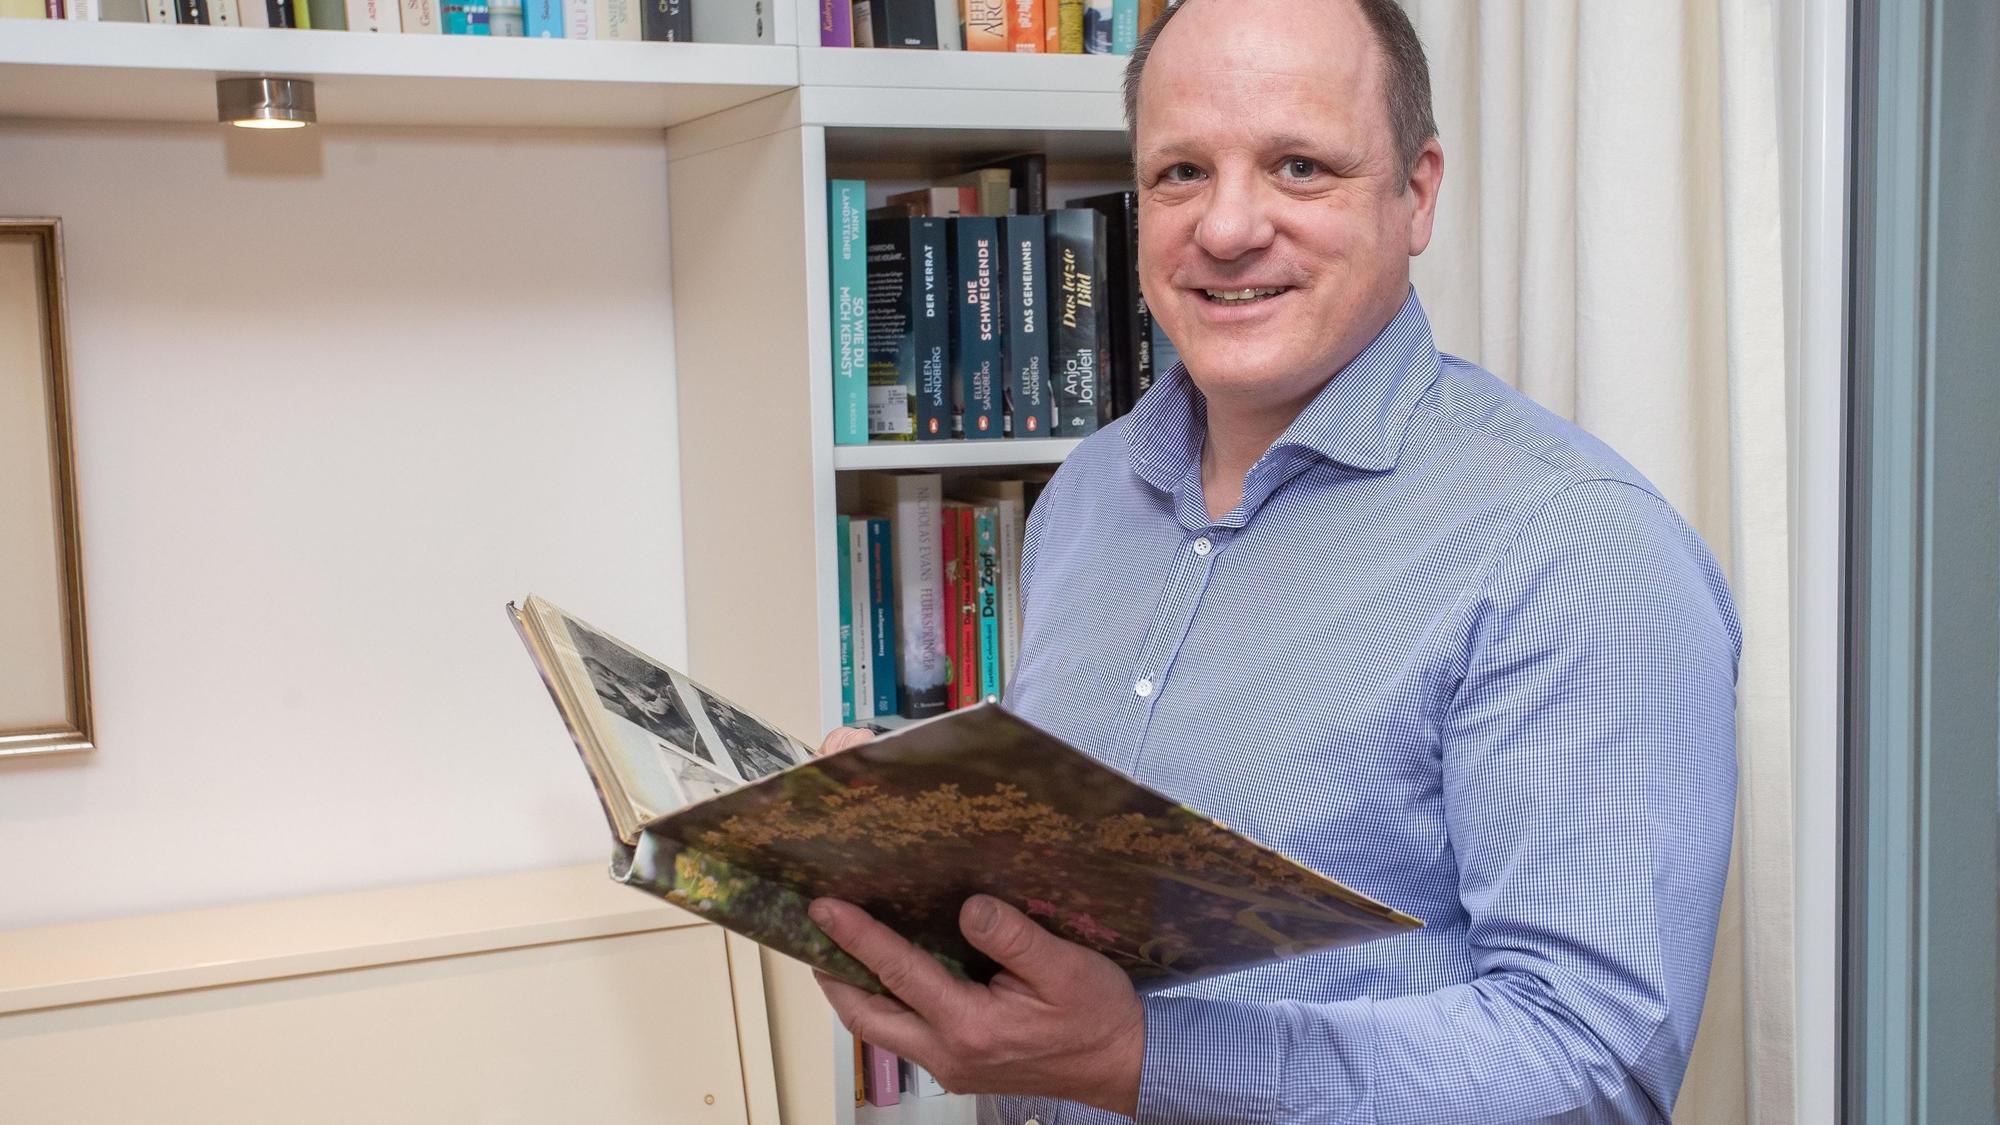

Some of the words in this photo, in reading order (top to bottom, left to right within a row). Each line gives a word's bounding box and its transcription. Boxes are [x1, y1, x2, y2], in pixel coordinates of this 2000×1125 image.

[842, 187, 851, 260] LANDSTEINER
[851, 207, 859, 241] ANIKA
[924, 245, 934, 294] VERRAT
[1022, 240, 1033, 306] GEHEIMNIS
[1062, 248, 1076, 296] letzte
[840, 286, 851, 320] MICH
[852, 297, 864, 316] SO
[967, 280, 978, 304] DIE
[978, 239, 991, 341] SCHWEIGENDE
[1077, 273, 1092, 309] Bild
[926, 298, 936, 318] DER
[1024, 308, 1034, 333] DAS
[1062, 298, 1077, 329] Das
[853, 319, 864, 344] WIE
[841, 323, 852, 378] KENNST
[853, 348, 864, 368] DU
[1139, 341, 1150, 370] Tieke
[924, 359, 933, 393] ELLEN
[932, 346, 942, 406] SANDBERG
[973, 371, 982, 402] ELLEN
[981, 361, 991, 411] SANDBERG
[1022, 367, 1031, 398] ELLEN
[1030, 356, 1040, 406] SANDBERG
[1065, 358, 1078, 396] Anja
[1078, 348, 1093, 406] Jonuleit
[1140, 374, 1151, 390] W.
[917, 487, 931, 545] NICHOLAS
[919, 547, 931, 582] EVANS
[980, 551, 996, 587] Zopf
[982, 590, 995, 618] Der
[920, 588, 935, 672] FEUERSPRINGER
